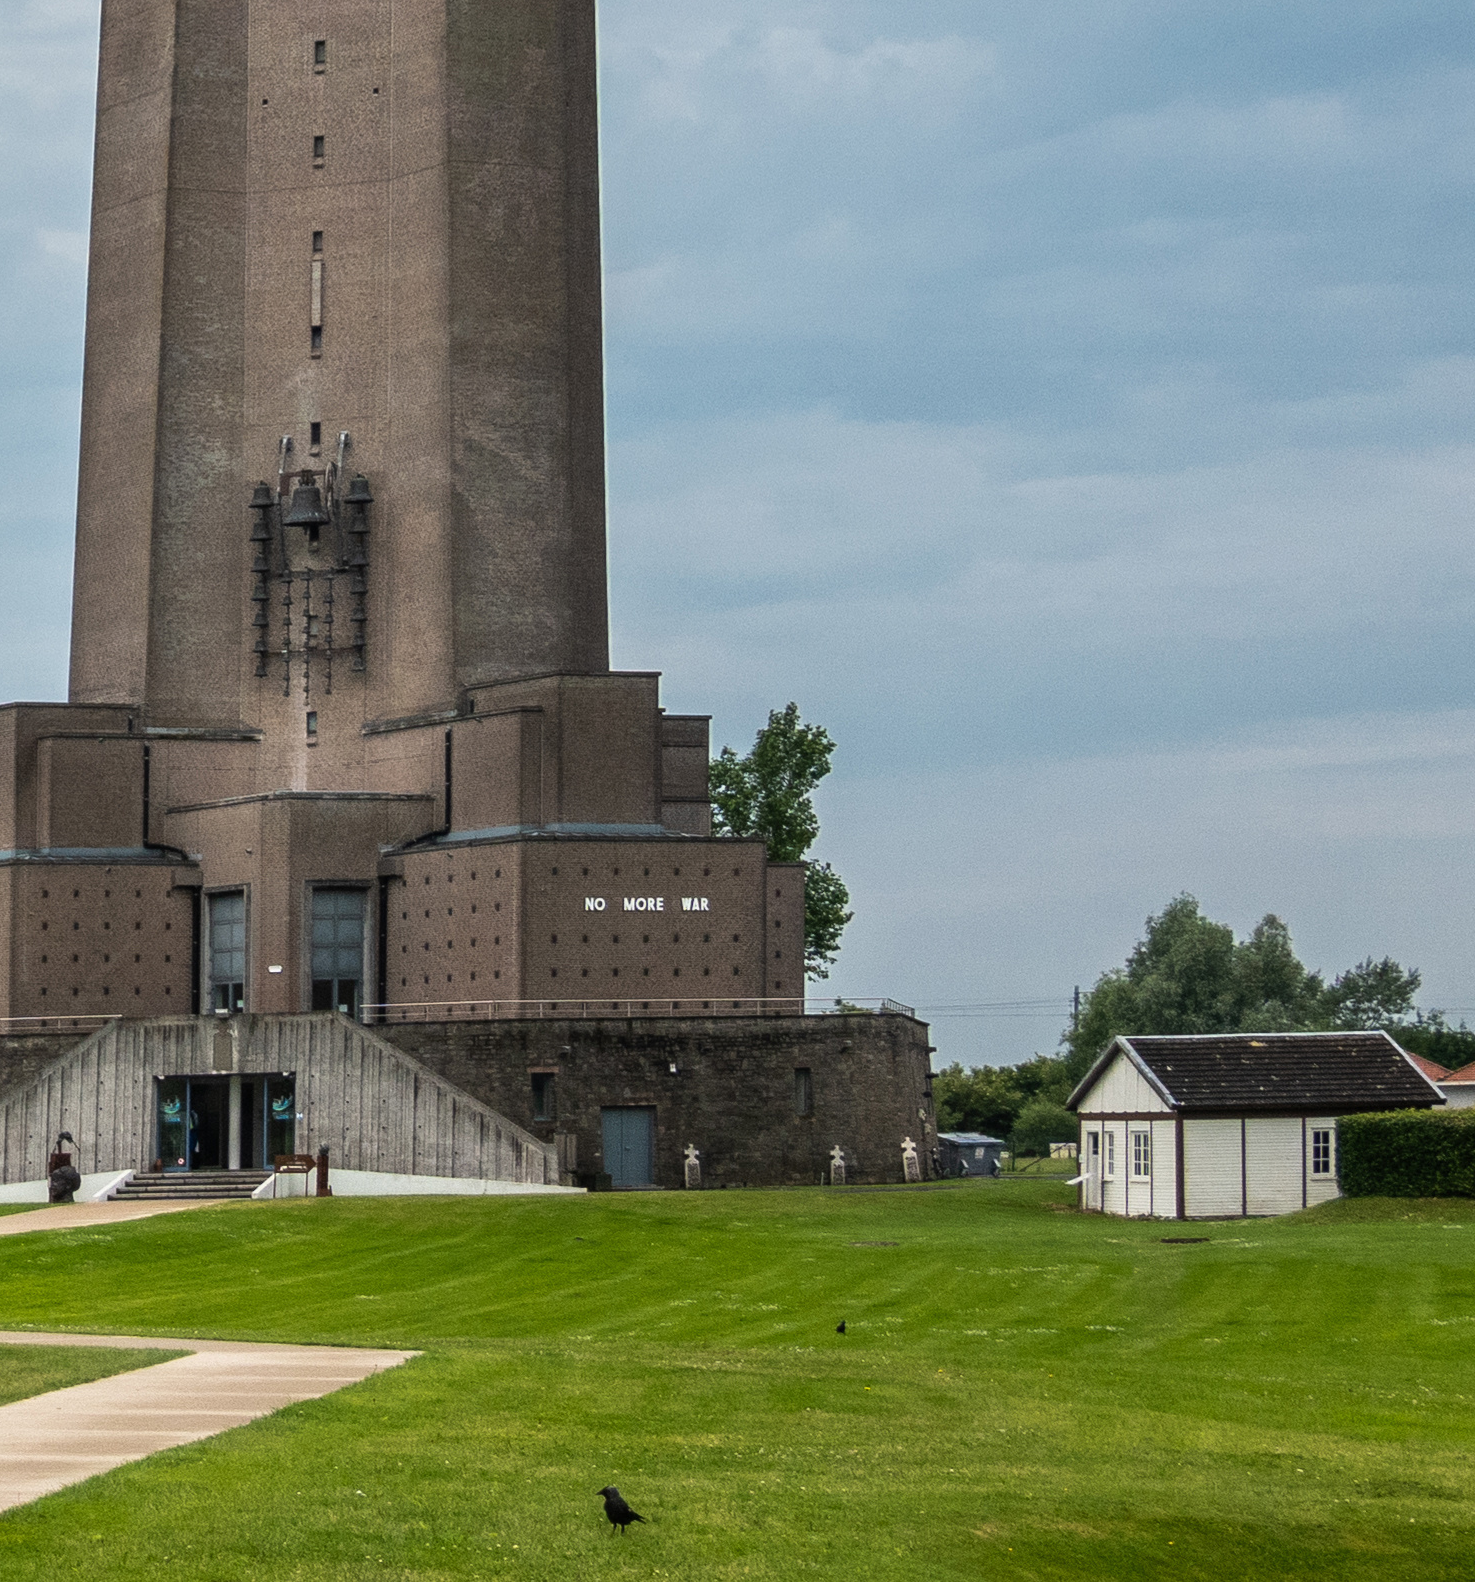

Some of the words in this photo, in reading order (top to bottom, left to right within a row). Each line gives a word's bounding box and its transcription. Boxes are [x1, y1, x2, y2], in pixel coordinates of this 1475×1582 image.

[584, 897, 606, 911] NO
[623, 897, 664, 911] MORE
[681, 897, 710, 911] WAR
